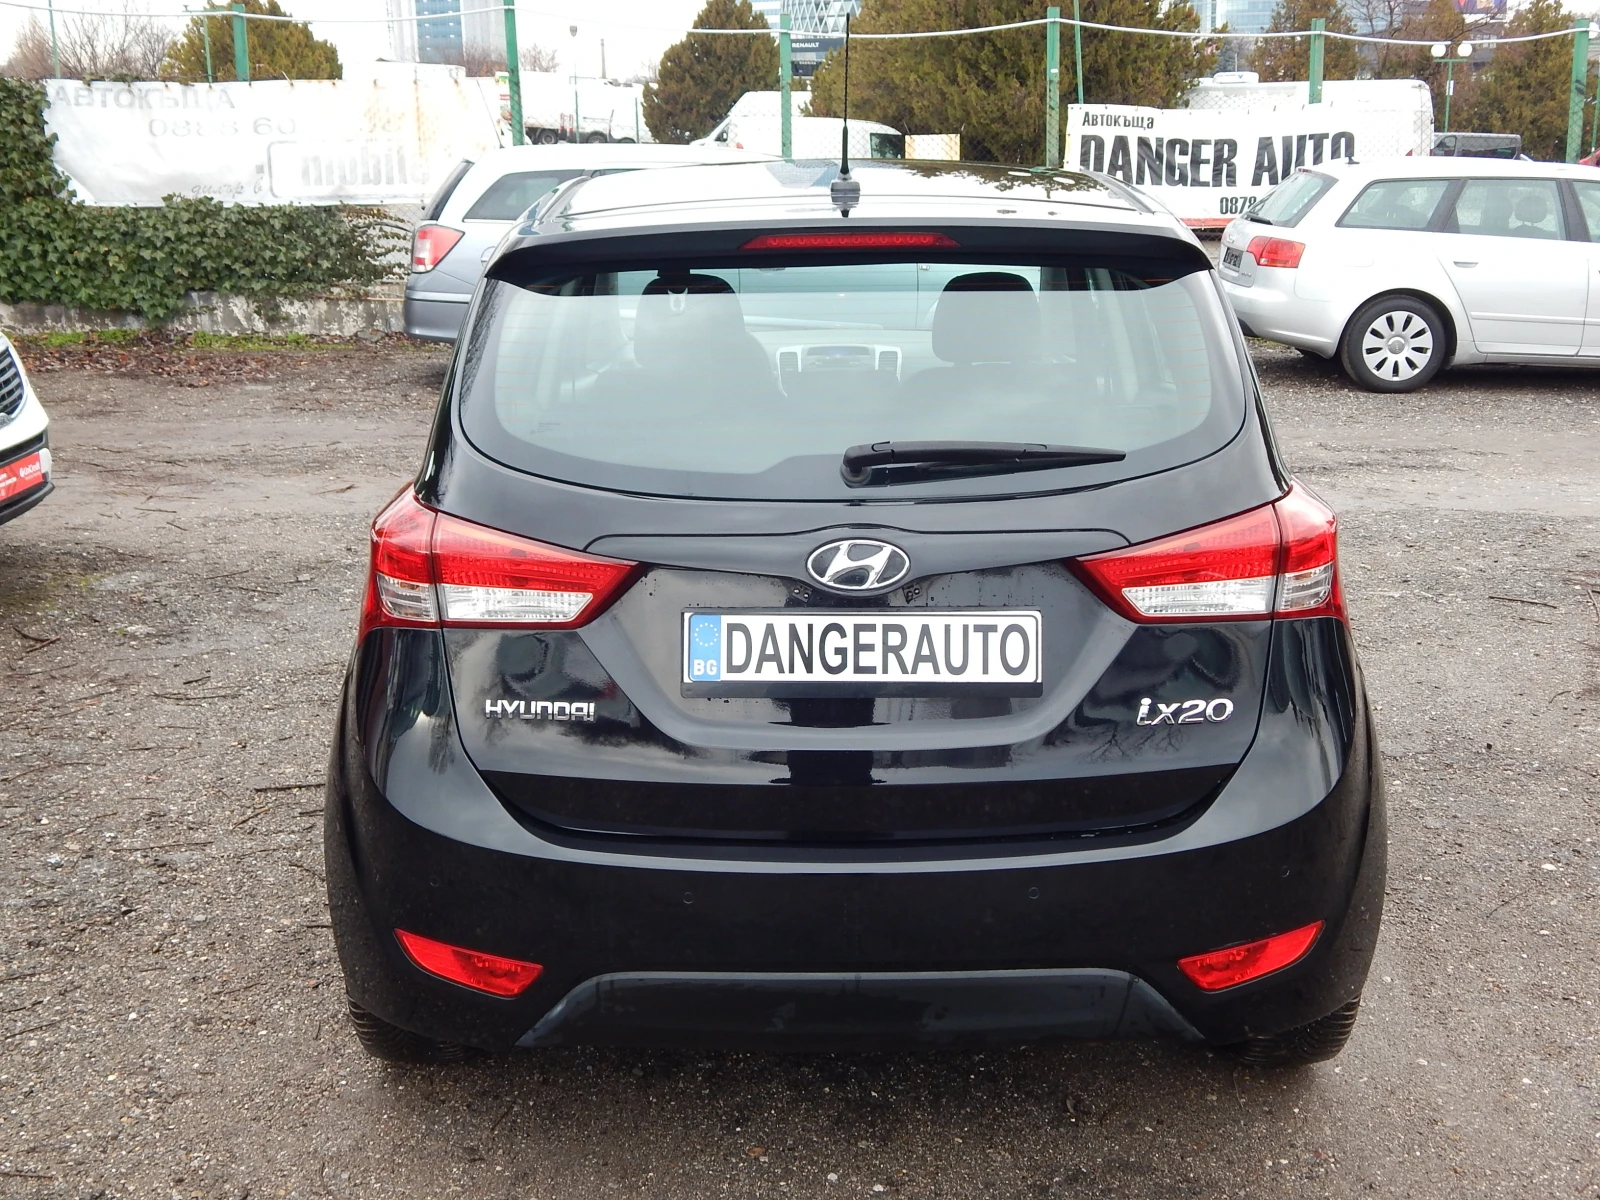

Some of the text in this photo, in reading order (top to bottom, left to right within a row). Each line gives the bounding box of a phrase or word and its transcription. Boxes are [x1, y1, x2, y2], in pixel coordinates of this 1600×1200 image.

[1082, 111, 1155, 130] Автокъща
[1080, 134, 1238, 188] DANGER
[725, 622, 1031, 676] DANGERAUTO
[693, 659, 717, 676] BG
[485, 699, 595, 722] HYUNDAI
[1136, 697, 1234, 726] ix20
